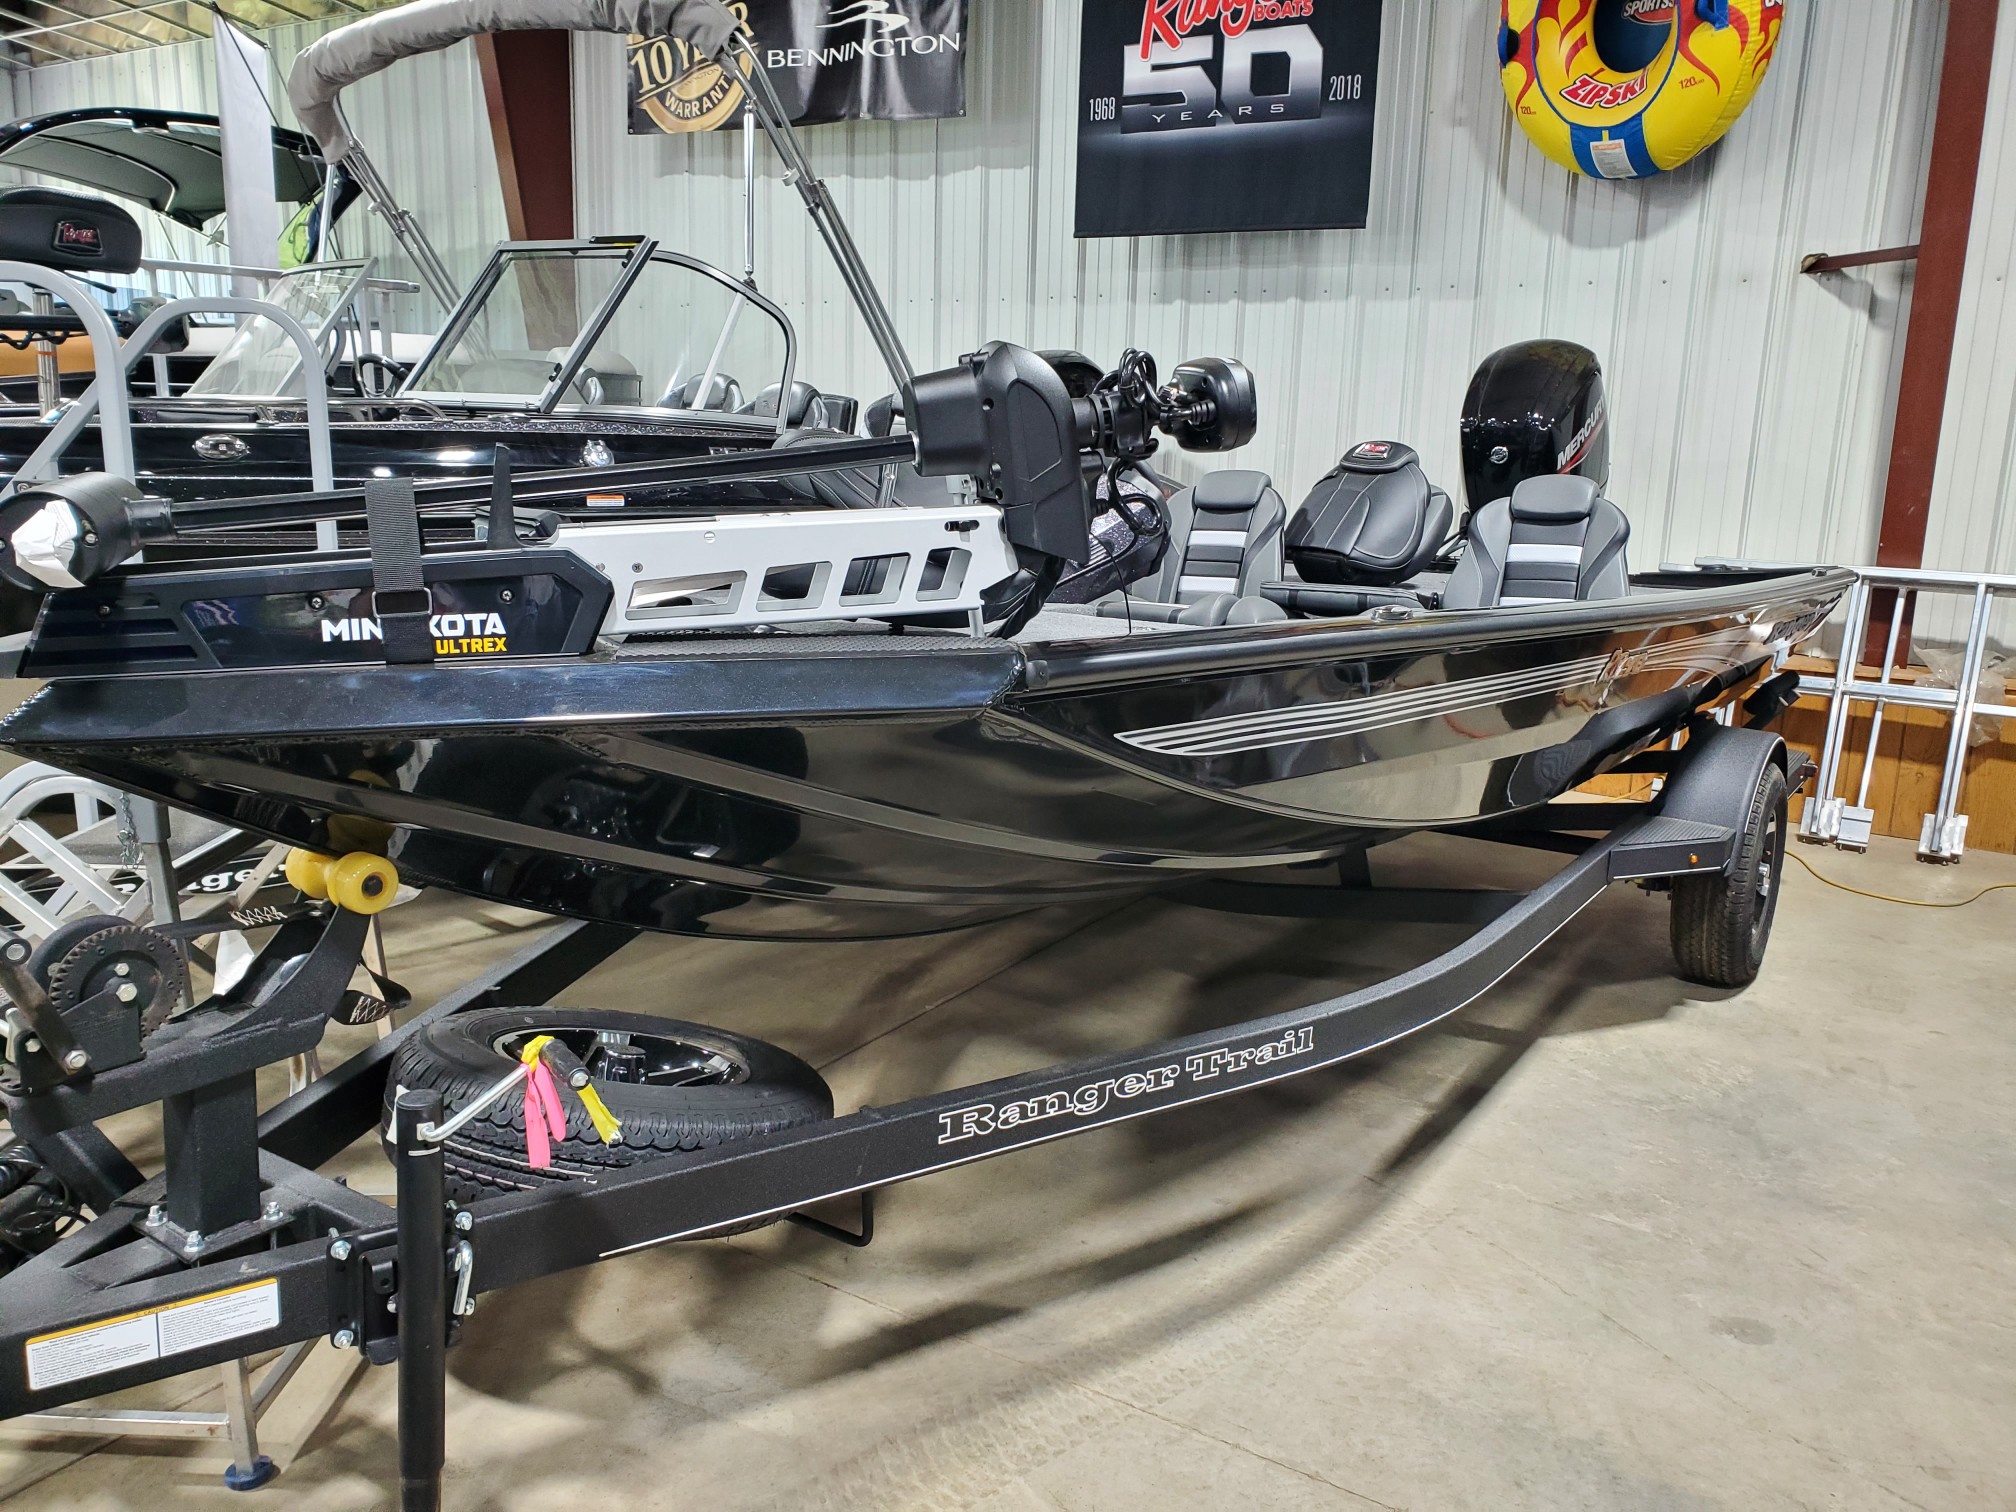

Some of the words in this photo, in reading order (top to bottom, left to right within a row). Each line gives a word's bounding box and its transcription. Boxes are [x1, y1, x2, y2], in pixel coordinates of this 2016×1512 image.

[1254, 0, 1314, 21] BOATS
[767, 33, 960, 69] BENNINGTON
[630, 41, 673, 93] 10
[1121, 23, 1324, 135] 50
[664, 72, 730, 118] WARRANT
[1329, 74, 1362, 100] 2018
[1089, 97, 1116, 121] 1968
[1152, 103, 1285, 123] YEARS
[1556, 395, 1605, 470] MERCUR
[321, 617, 383, 642] MIN
[435, 637, 507, 655] ULTREX
[938, 1064, 1180, 1144] Ranger
[1186, 1026, 1314, 1081] Trail
